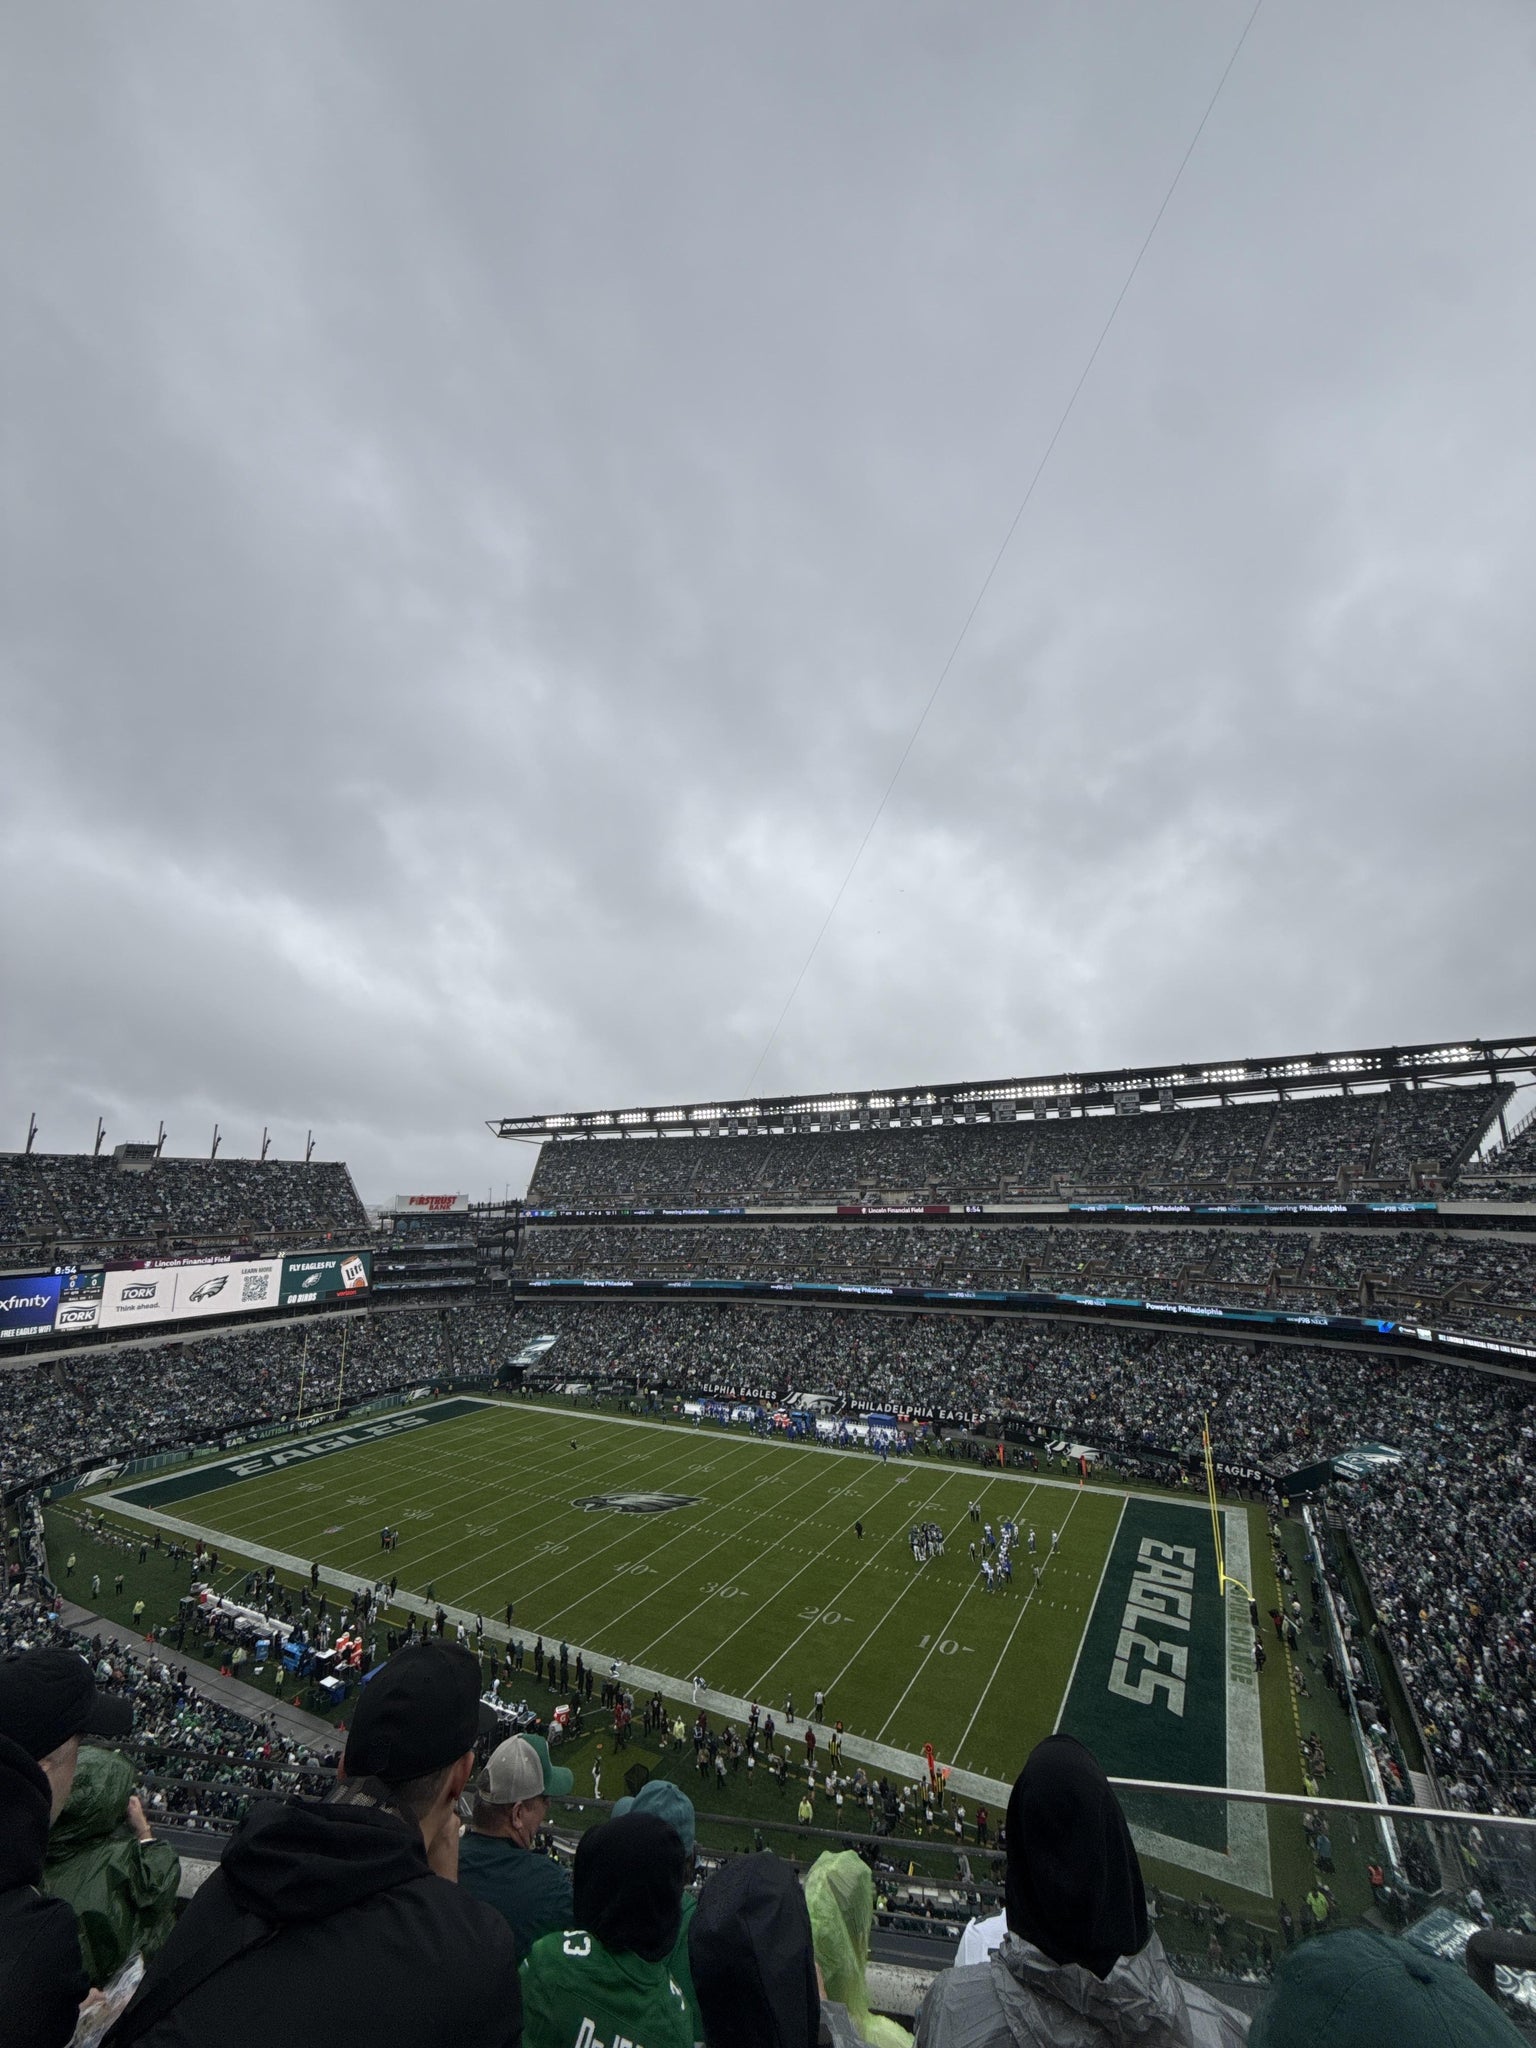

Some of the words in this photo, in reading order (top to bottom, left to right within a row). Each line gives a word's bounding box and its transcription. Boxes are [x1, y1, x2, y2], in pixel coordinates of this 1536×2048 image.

[54, 1266, 77, 1275] 8:54
[289, 1263, 302, 1272] FLY
[302, 1262, 325, 1271] EAGLES
[325, 1260, 337, 1268] FLY
[122, 1287, 155, 1299] TORK
[287, 1294, 297, 1304] GO
[297, 1292, 318, 1303] BIRDS
[0, 1294, 51, 1311] xfinity
[116, 1304, 136, 1312] Think
[1146, 1303, 1178, 1313] Powering
[1178, 1305, 1223, 1316] Philadelphia
[61, 1310, 94, 1323] TORK
[0, 1330, 16, 1338] FREE
[16, 1326, 38, 1336] EAGLES
[38, 1325, 52, 1333] WIFI
[740, 1388, 777, 1400] EAGLES
[851, 1400, 934, 1418] PHILADELPHIA
[939, 1410, 986, 1423] EAGLES
[259, 1424, 289, 1439] AUTISM
[226, 1415, 430, 1477] EAGLES
[534, 1540, 570, 1555] 50
[612, 1561, 650, 1576] 40
[698, 1582, 740, 1598] 30
[796, 1605, 842, 1625] 20
[1108, 1536, 1196, 1718] EAGLES
[915, 1634, 960, 1656] 10
[1230, 1626, 1253, 1686] CHANGE
